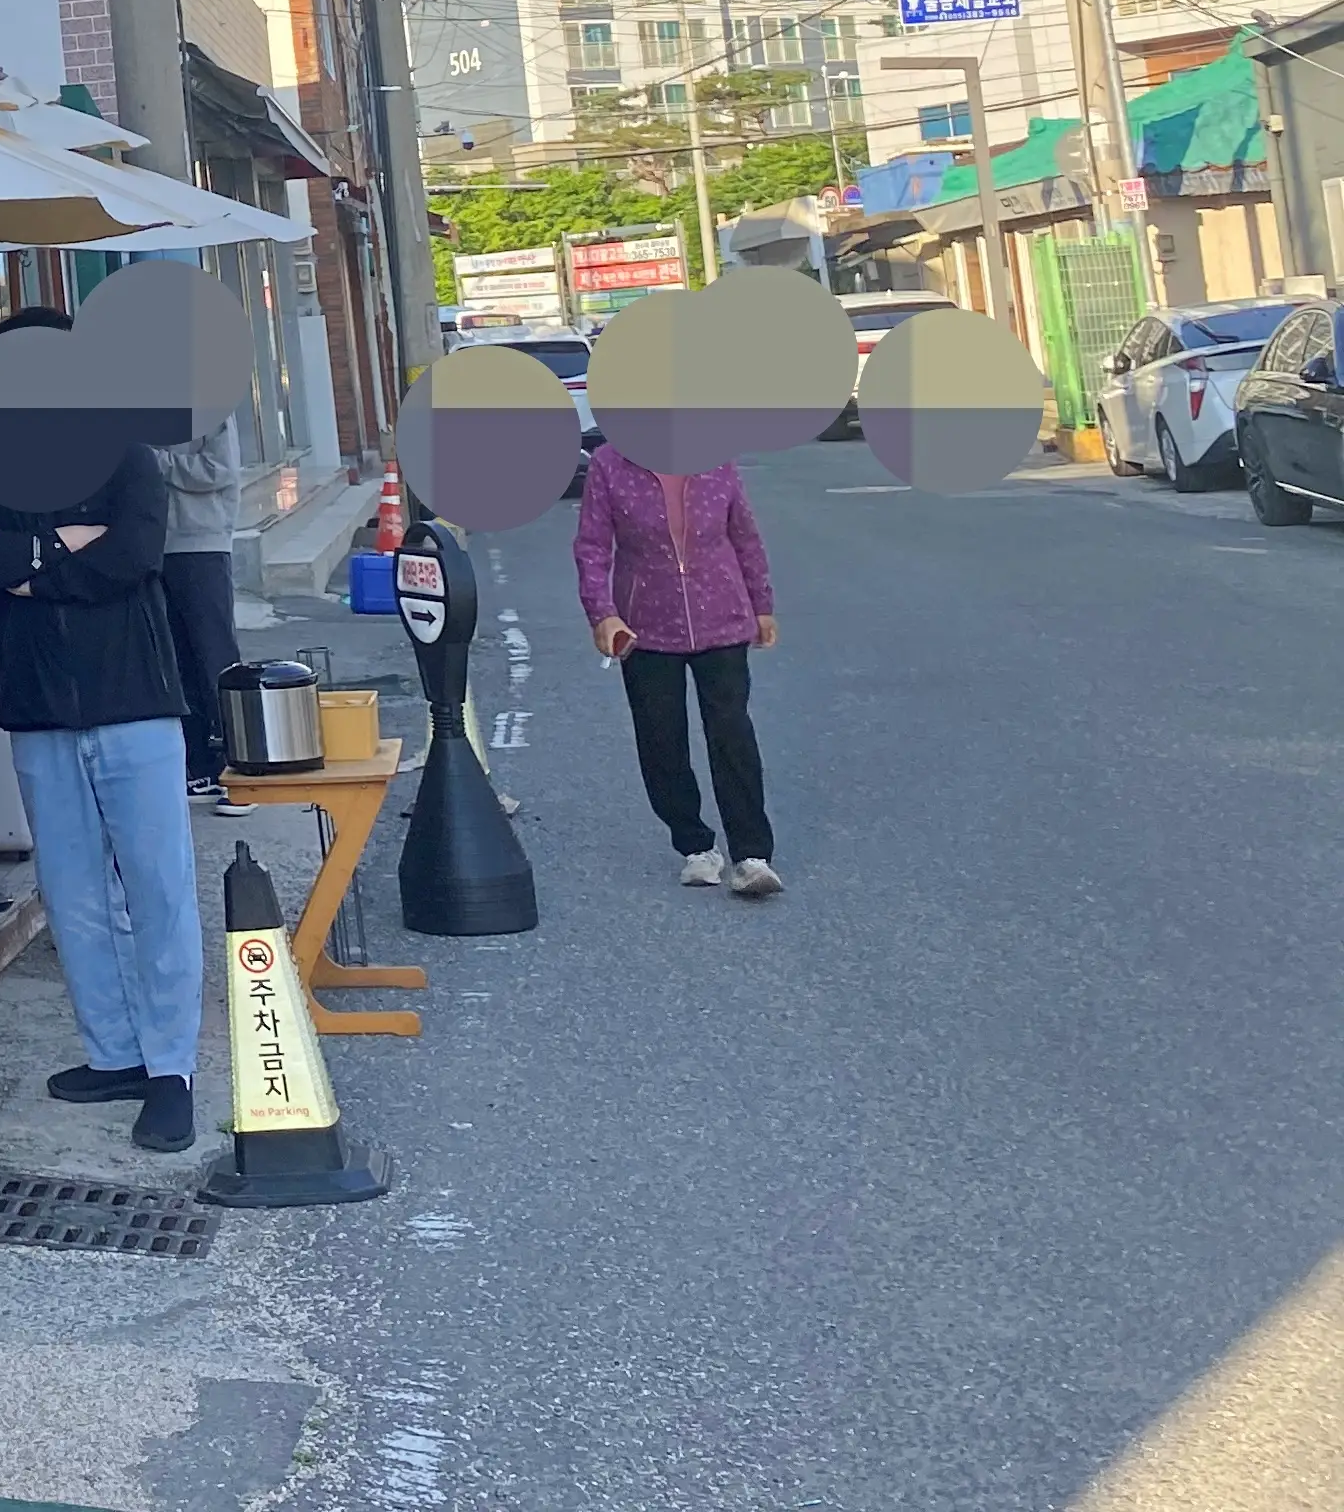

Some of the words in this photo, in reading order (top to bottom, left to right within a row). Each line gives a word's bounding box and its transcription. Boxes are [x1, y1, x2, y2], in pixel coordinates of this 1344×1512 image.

[449, 46, 482, 77] 504
[249, 979, 290, 1102] 주차금지
[250, 1108, 265, 1118] No
[268, 1106, 310, 1119] Parking
